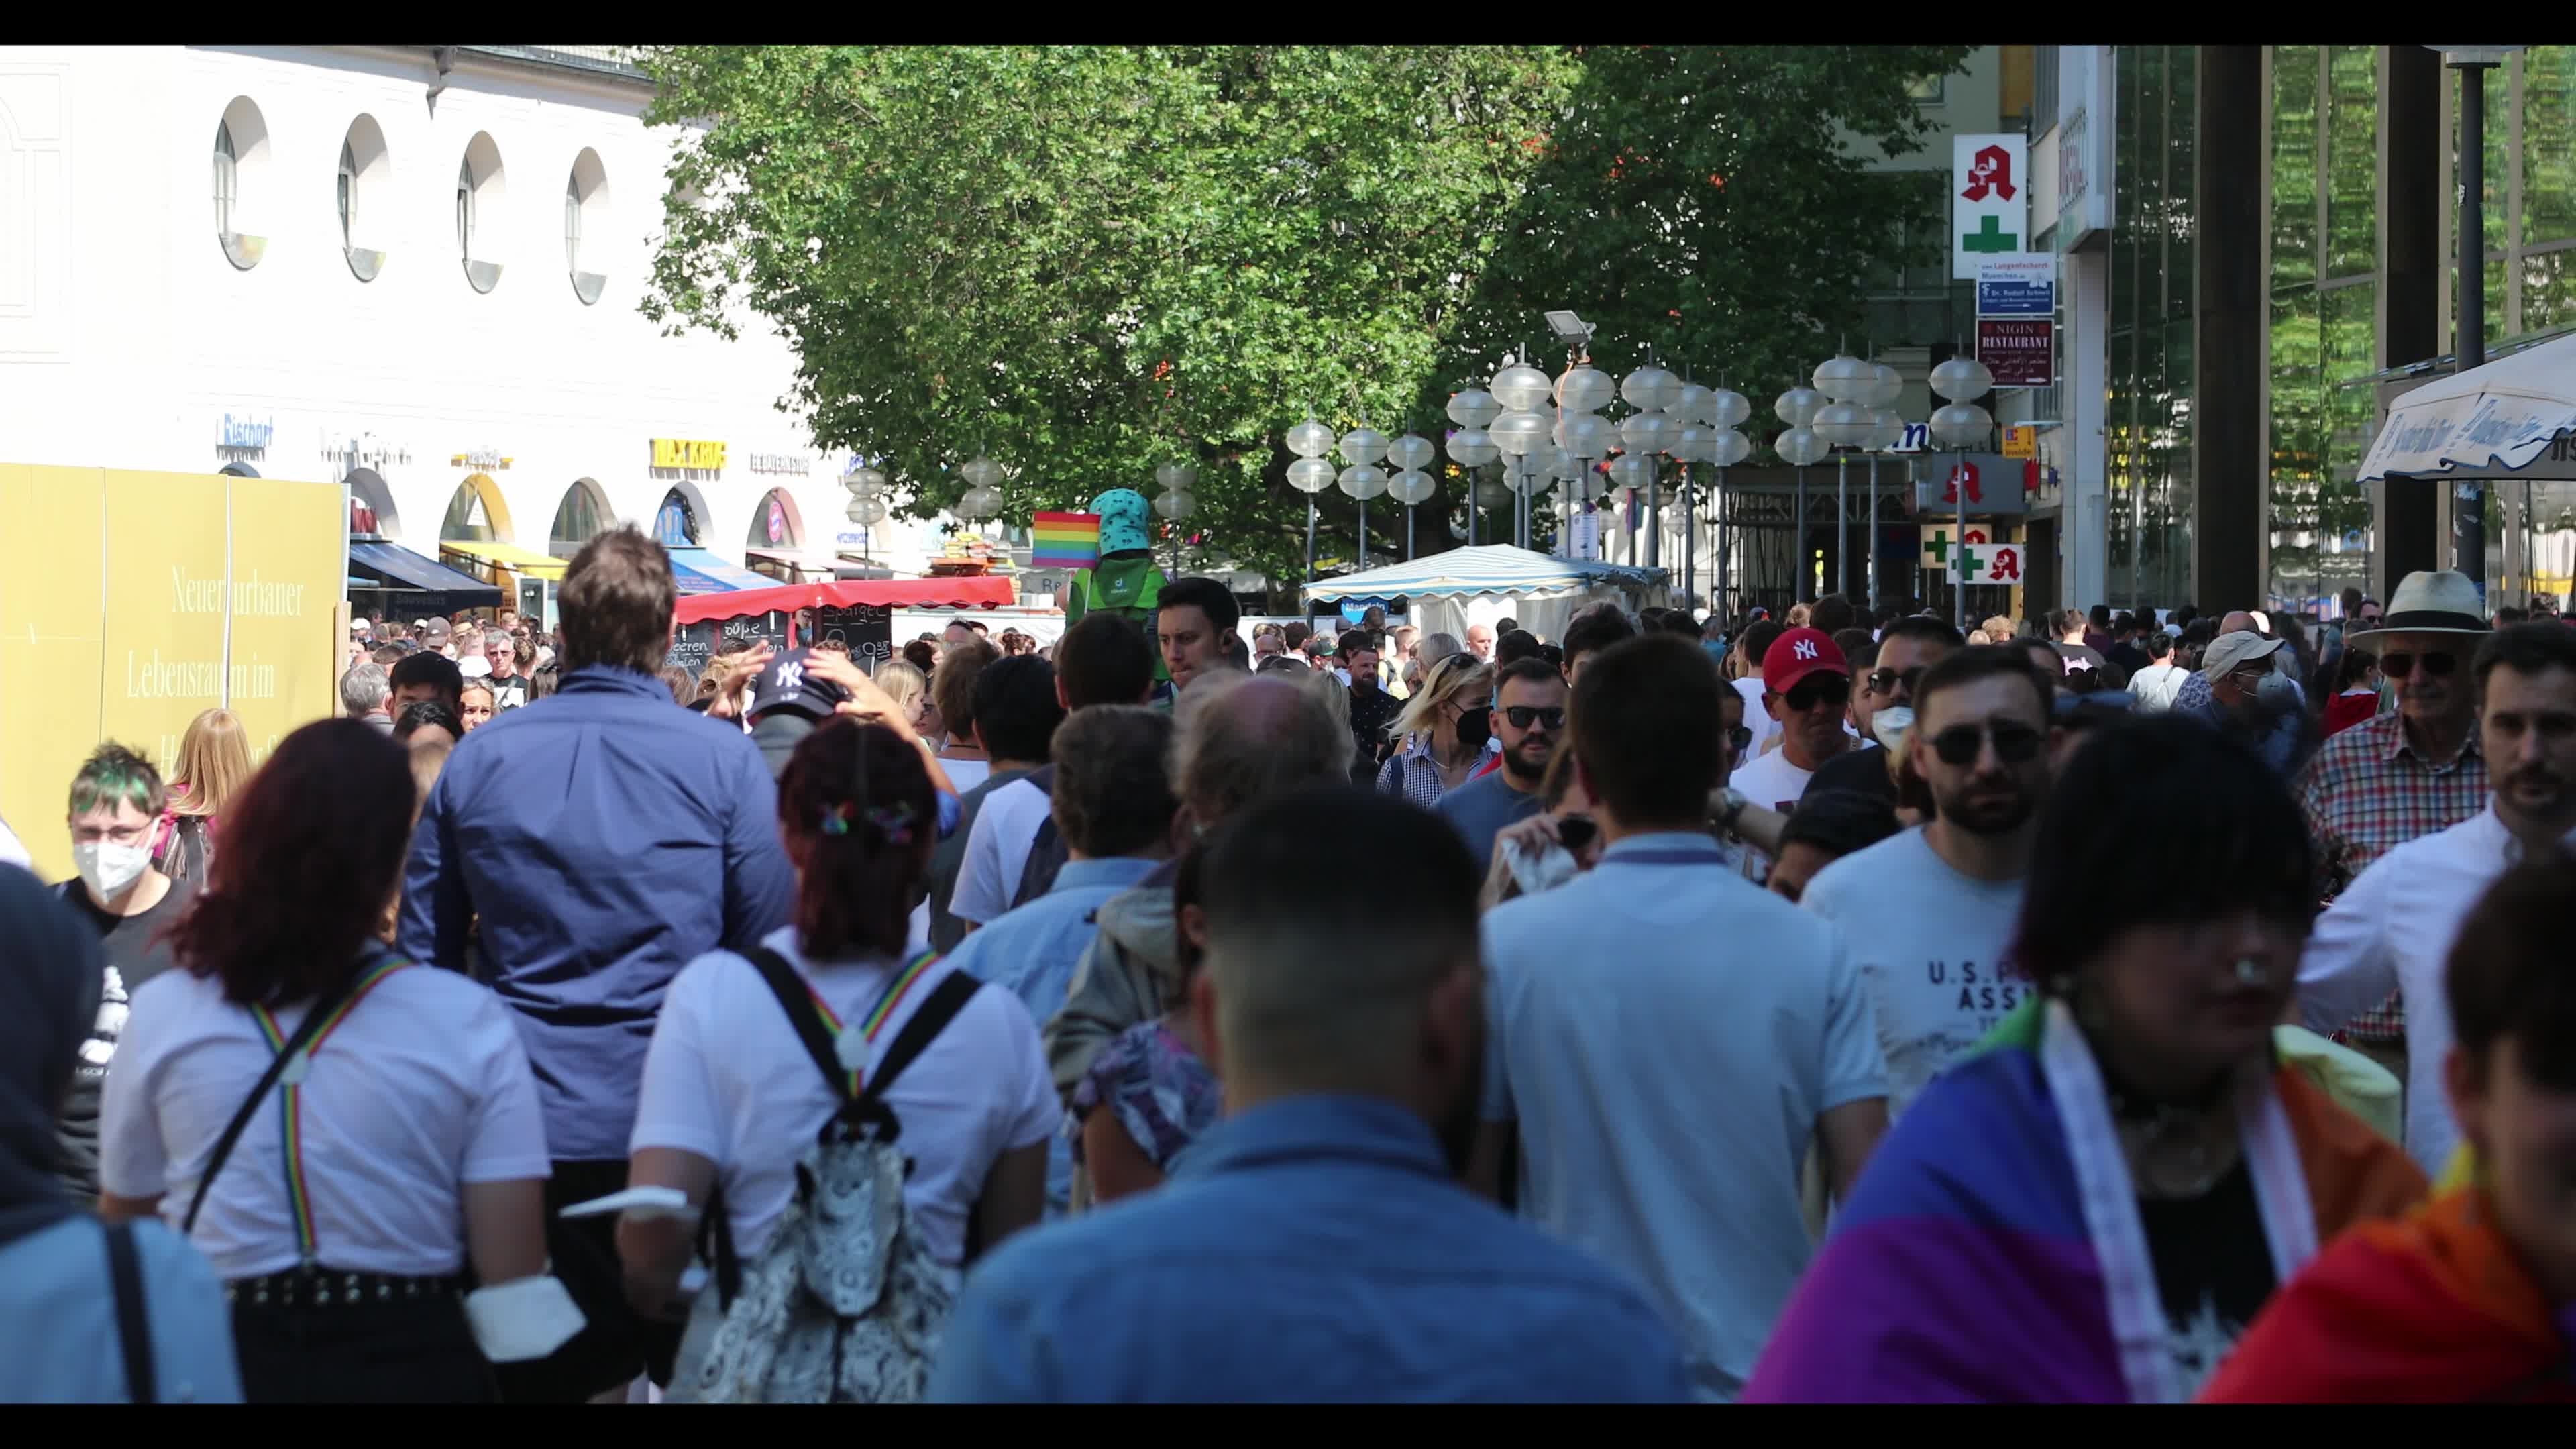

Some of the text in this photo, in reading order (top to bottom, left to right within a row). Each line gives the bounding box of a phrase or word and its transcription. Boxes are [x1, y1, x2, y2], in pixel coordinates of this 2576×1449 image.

[1996, 324, 2035, 334] NIGIN
[1982, 336, 2048, 349] RESTAURANT
[171, 566, 304, 616] Neuer urbaner
[1793, 638, 1819, 660] NY
[127, 649, 274, 698] Lebensraum im
[776, 661, 804, 688] NY
